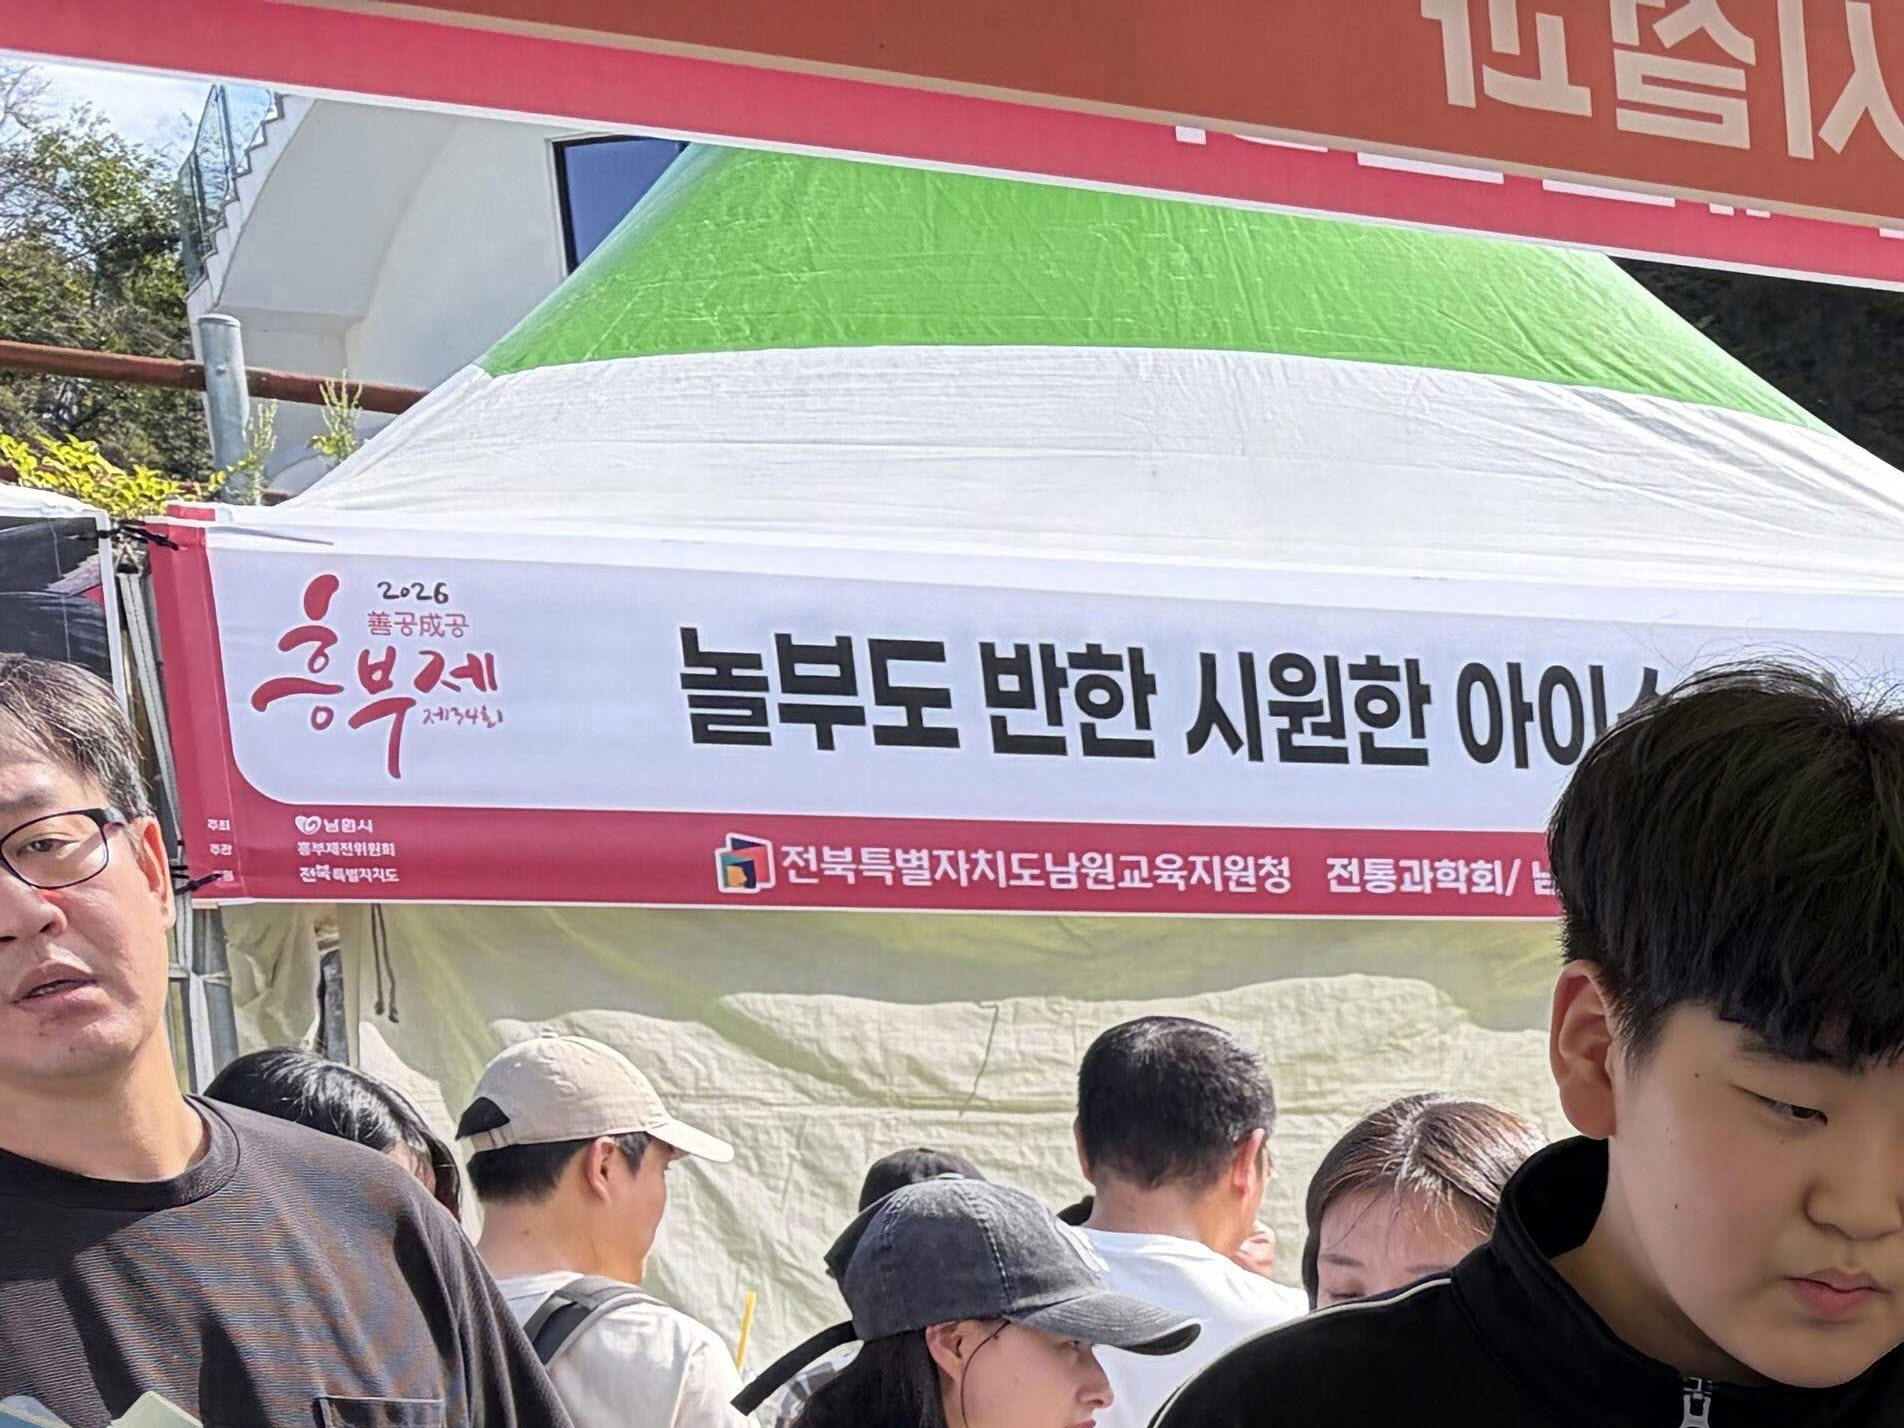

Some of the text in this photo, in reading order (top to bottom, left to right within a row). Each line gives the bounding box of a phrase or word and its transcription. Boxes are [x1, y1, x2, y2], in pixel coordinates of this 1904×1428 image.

[377, 581, 450, 604] 2026
[367, 610, 470, 639] 善공成공
[251, 573, 498, 780] 흥부제
[679, 624, 961, 754] 놀부도
[979, 638, 1158, 760] 반한
[1186, 650, 1432, 769] 시원한
[322, 817, 374, 834] 남원시
[296, 840, 396, 857] 흥부제전위원회
[298, 863, 400, 884] 전북특별자치도
[780, 846, 1522, 898] 전북특별자치도남원교육지원청 전통과학회/
